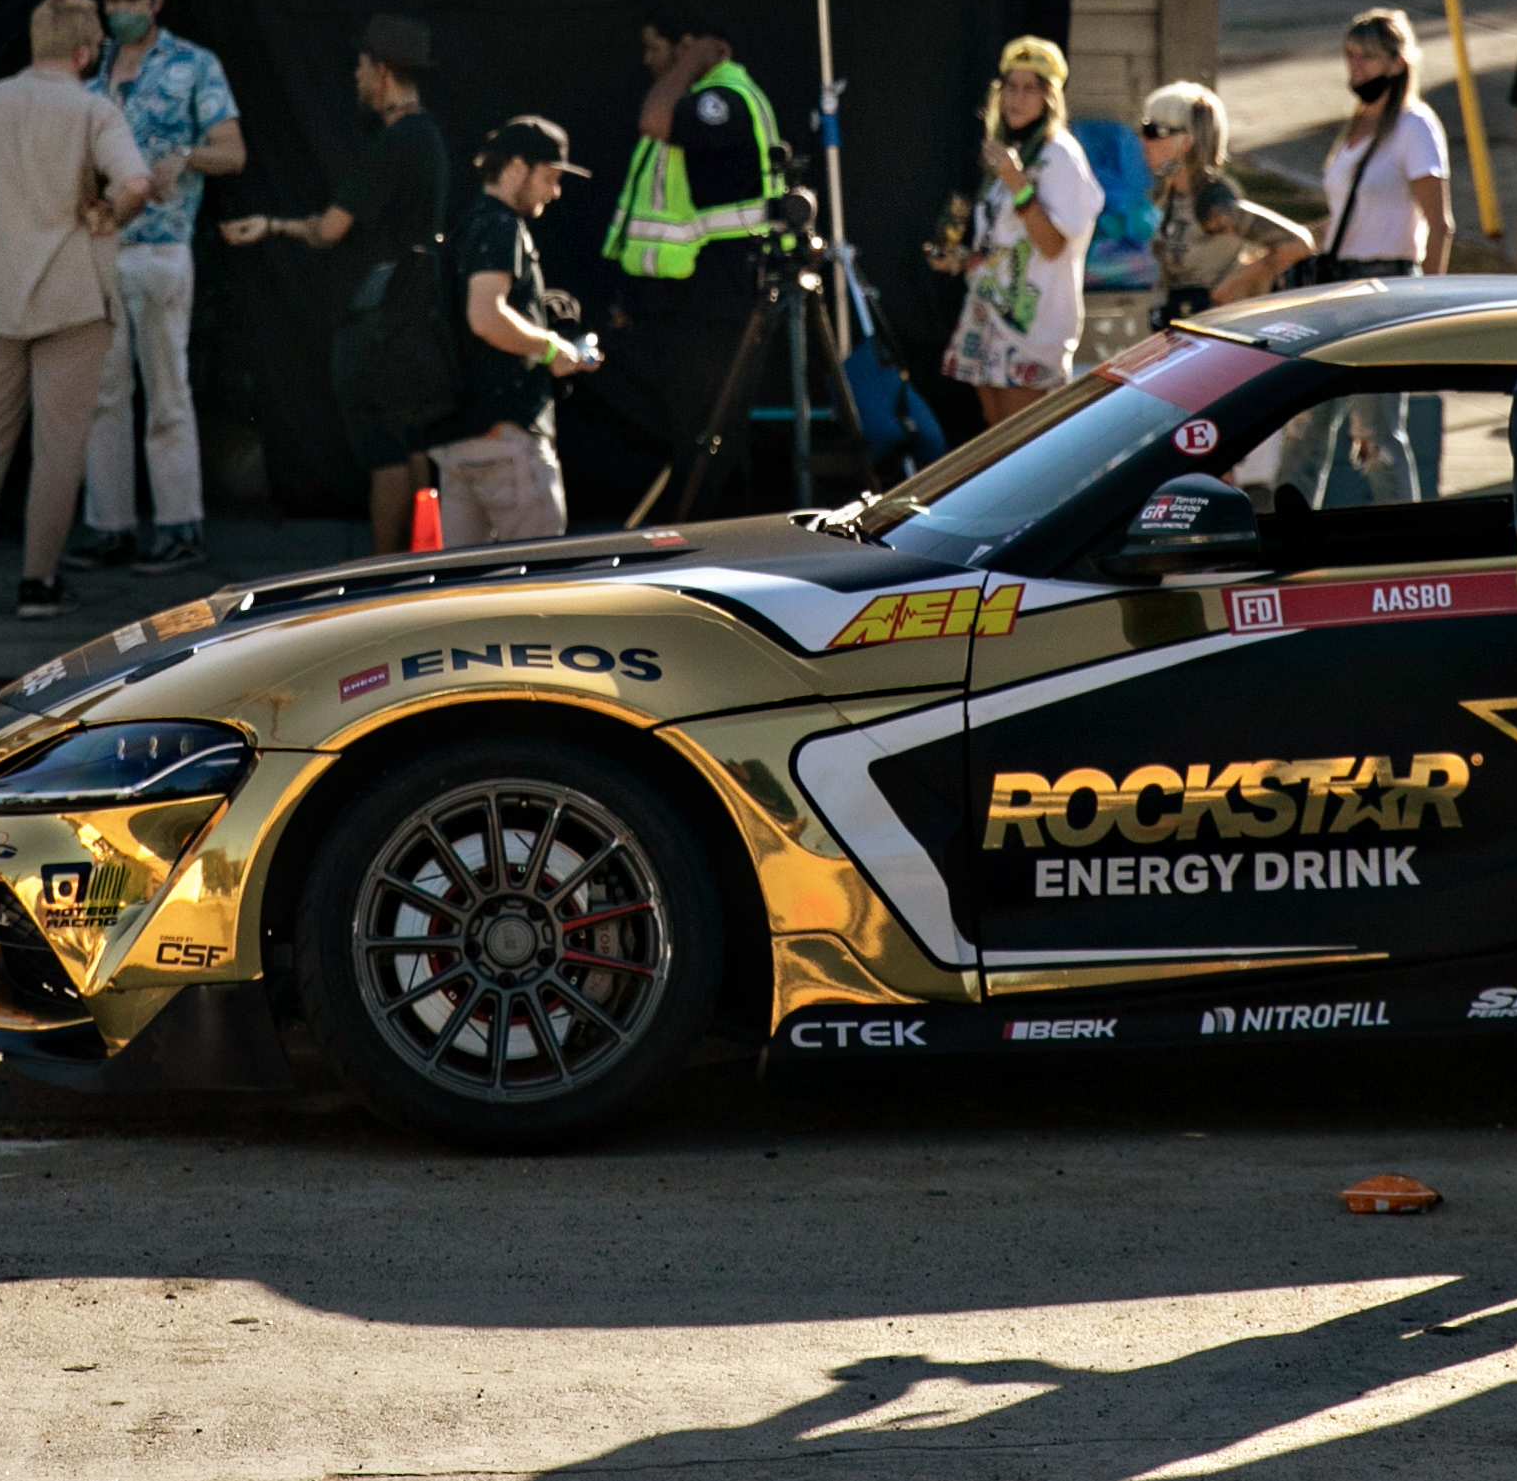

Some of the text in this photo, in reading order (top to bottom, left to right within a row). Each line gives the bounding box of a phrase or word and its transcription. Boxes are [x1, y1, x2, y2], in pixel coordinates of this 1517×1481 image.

[1174, 496, 1209, 505] TOYOTA
[1243, 597, 1272, 624] FD
[1371, 583, 1451, 613] AASBO
[826, 583, 1026, 649] AEM
[401, 643, 663, 682] ENEOS
[342, 672, 386, 694] ENEOS
[982, 751, 1471, 850] ROCKSTAR
[1034, 845, 1421, 898] ENERGY DRINK
[46, 906, 118, 918] MOTEGI
[156, 942, 228, 968] CSF
[1027, 1017, 1118, 1041] BERK
[1240, 1001, 1390, 1034] NITROFILL
[790, 1019, 927, 1049] CTEK
